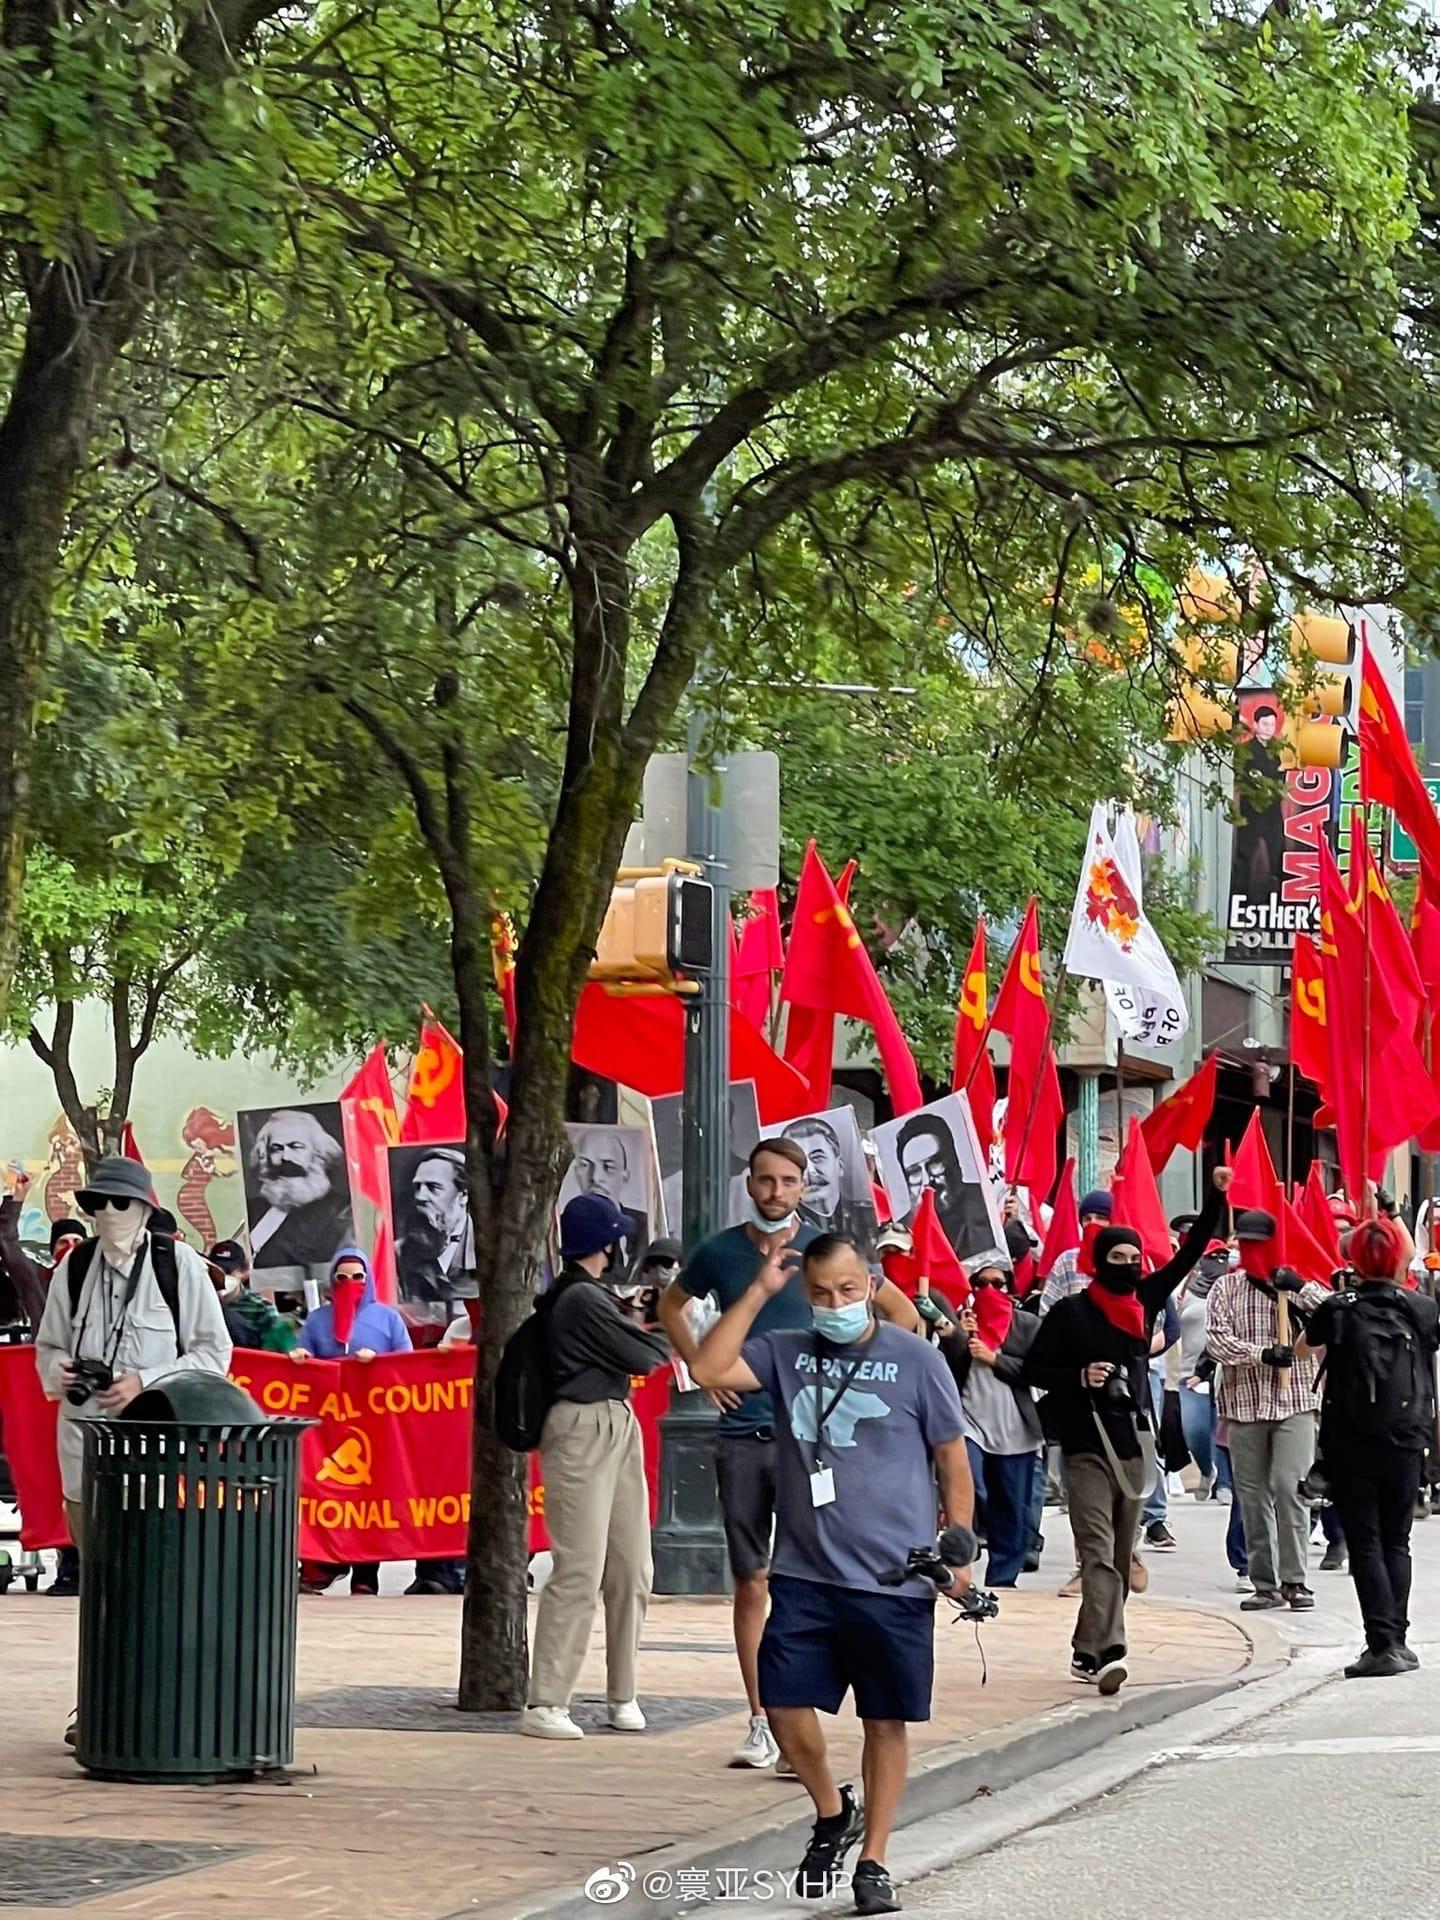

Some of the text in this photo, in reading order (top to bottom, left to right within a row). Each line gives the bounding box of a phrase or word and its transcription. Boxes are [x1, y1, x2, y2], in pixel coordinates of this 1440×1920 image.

[1281, 764, 1332, 902] MAG
[794, 1353, 843, 1379] PAPA
[263, 1380, 311, 1411] OF
[367, 1377, 474, 1415] COUNT
[299, 1497, 400, 1530] TIONAL
